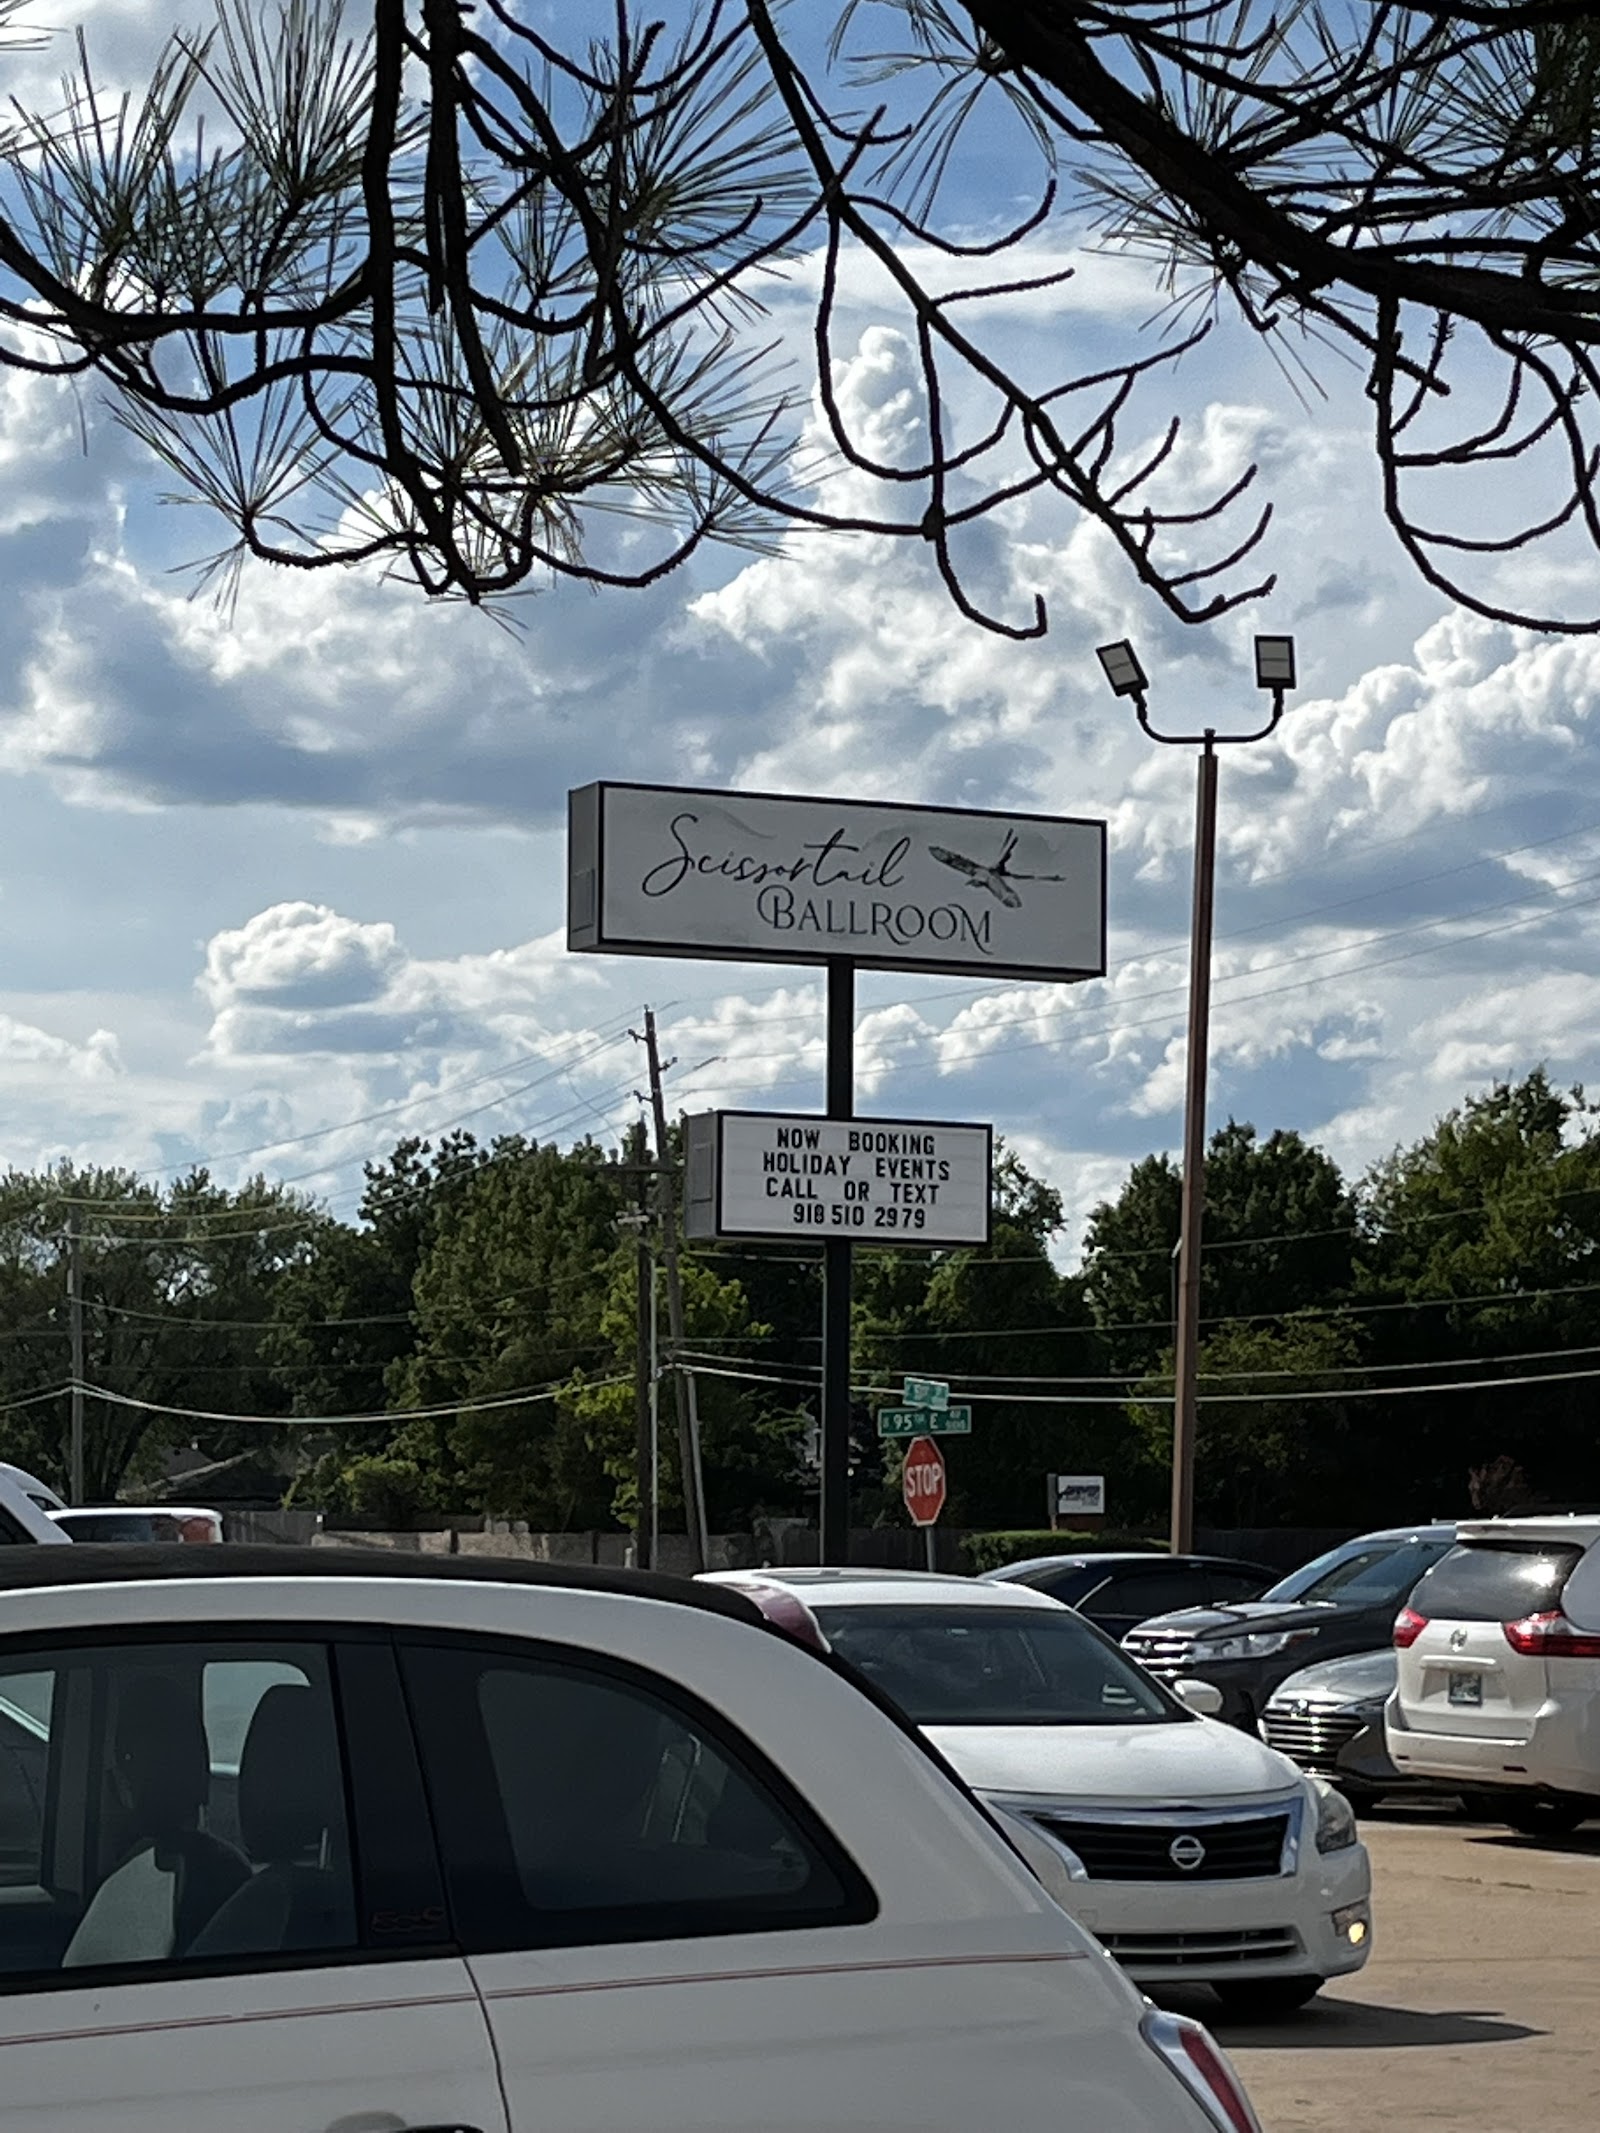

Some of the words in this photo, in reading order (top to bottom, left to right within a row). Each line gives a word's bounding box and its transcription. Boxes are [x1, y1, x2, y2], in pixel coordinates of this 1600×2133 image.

[642, 813, 911, 896] Scissortail
[757, 885, 994, 955] BALLROOM
[777, 1127, 820, 1149] NOW
[849, 1130, 935, 1155] BOOKING
[763, 1151, 851, 1176] HOLIDAY
[875, 1157, 950, 1181] EVENTS
[766, 1177, 818, 1199] CALL
[844, 1181, 870, 1201] OR
[890, 1183, 940, 1204] TEXT
[793, 1203, 825, 1225] 918
[831, 1204, 864, 1226] 510
[874, 1206, 925, 1229] 2979
[930, 1412, 939, 1430] E
[906, 1462, 942, 1498] STOP
